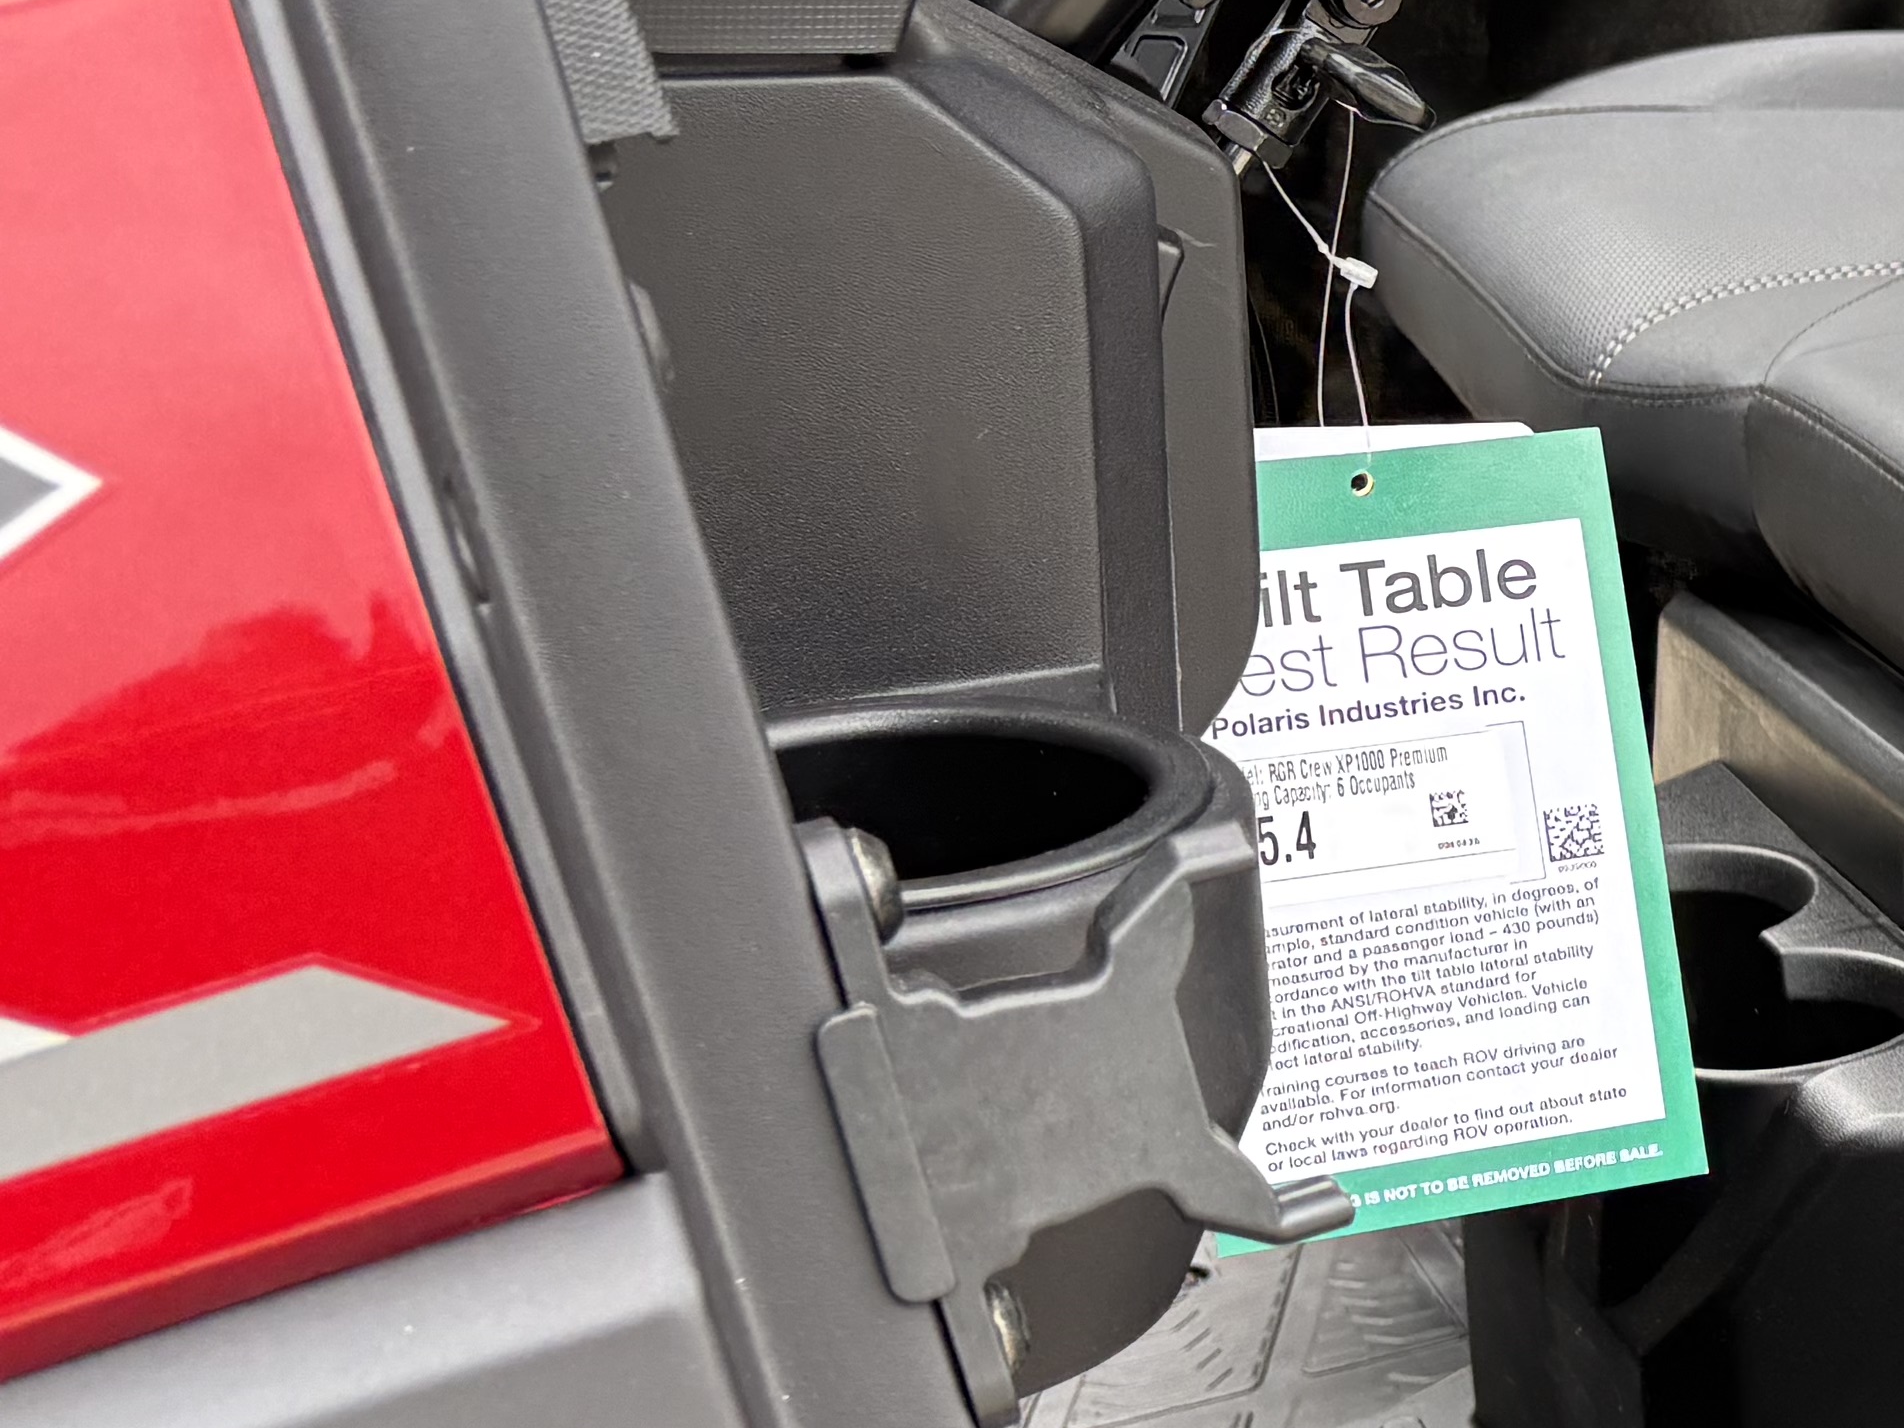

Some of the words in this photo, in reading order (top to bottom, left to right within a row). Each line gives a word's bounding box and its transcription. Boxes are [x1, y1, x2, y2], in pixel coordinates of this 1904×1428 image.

[1259, 568, 1323, 629] ilt
[1337, 547, 1538, 618] Table
[1238, 633, 1339, 697] est
[1356, 605, 1567, 685] Result
[1210, 707, 1311, 741] Polaris
[1317, 690, 1465, 728] Industries
[1471, 684, 1526, 708] Inc.
[1244, 762, 1266, 787] el:
[1266, 759, 1298, 784] RGR
[1298, 757, 1333, 781] Crew
[1333, 747, 1386, 775] XP1000
[1388, 745, 1449, 769] Premium
[1272, 780, 1332, 808] Capacity:
[1335, 775, 1346, 799] 6
[1348, 769, 1417, 797] Occupants
[1255, 809, 1318, 867] 5.4
[1319, 924, 1390, 947] standard
[1394, 915, 1469, 936] condition
[1473, 905, 1529, 924] vehicle
[1576, 896, 1595, 909] an
[1348, 910, 1364, 926] of
[1368, 903, 1419, 923] lateral
[1423, 896, 1488, 915] stability,
[1492, 893, 1507, 905] in
[1583, 876, 1599, 891] of
[1271, 955, 1308, 970] rator
[1313, 948, 1343, 965] and
[1362, 934, 1445, 959] passenger
[1449, 927, 1484, 944] load
[1274, 984, 1339, 1004] ordance
[1342, 977, 1377, 993] with
[1380, 974, 1406, 987] the
[1410, 968, 1431, 982] tilt
[1435, 962, 1475, 979] table
[1479, 953, 1529, 972] lateral
[1533, 944, 1594, 964] stability
[1348, 963, 1369, 976] by
[1373, 959, 1399, 972] the
[1403, 941, 1509, 967] manufacturer
[1513, 938, 1528, 951] in
[1269, 1013, 1349, 1040] creational
[1353, 1000, 1453, 1025] Off-Highway
[1530, 977, 1588, 996] Vehicle
[1281, 1006, 1297, 1019] in
[1300, 1003, 1326, 1016] the
[1440, 972, 1511, 995] standard
[1514, 970, 1537, 983] for
[1268, 1032, 1356, 1055] odification,
[1359, 1016, 1461, 1040] accessories,
[1464, 1007, 1494, 1025] and
[1498, 1000, 1557, 1019] loading
[1561, 995, 1590, 1009] can
[1260, 1092, 1334, 1115] available.
[1339, 1087, 1366, 1101] For
[1370, 1073, 1462, 1097] information
[1465, 1061, 1526, 1082] contact
[1530, 1056, 1564, 1074] your
[1569, 1047, 1618, 1065] dealer
[1303, 1046, 1353, 1066] lateral
[1324, 1068, 1389, 1087] courses
[1392, 1064, 1409, 1077] to
[1413, 1055, 1458, 1073] teach
[1462, 1047, 1498, 1065] ROV
[1502, 1041, 1557, 1059] driving
[1560, 1036, 1585, 1050] are
[1261, 1112, 1314, 1132] and/or
[1264, 1136, 1317, 1156] Check
[1320, 1130, 1355, 1146] with
[1358, 1124, 1394, 1143] your
[1399, 1116, 1449, 1134] dealer
[1452, 1112, 1470, 1125] to
[1473, 1104, 1504, 1121] find
[1508, 1100, 1535, 1116] out
[1539, 1092, 1584, 1111] about
[1588, 1087, 1627, 1103] state
[1267, 1160, 1284, 1172] or
[1288, 1150, 1327, 1169] local
[1331, 1147, 1368, 1161] laws
[1372, 1133, 1449, 1155] regarding
[1452, 1123, 1488, 1141] ROV
[1493, 1113, 1573, 1136] operation.
[1363, 1189, 1382, 1206] IS
[1382, 1182, 1419, 1203] NOT
[1418, 1179, 1445, 1196] TO
[1445, 1174, 1471, 1193] BE
[1470, 1161, 1552, 1188] REMOVED
[1552, 1150, 1618, 1174] BEFORE
[1618, 1142, 1662, 1163] SALE.
